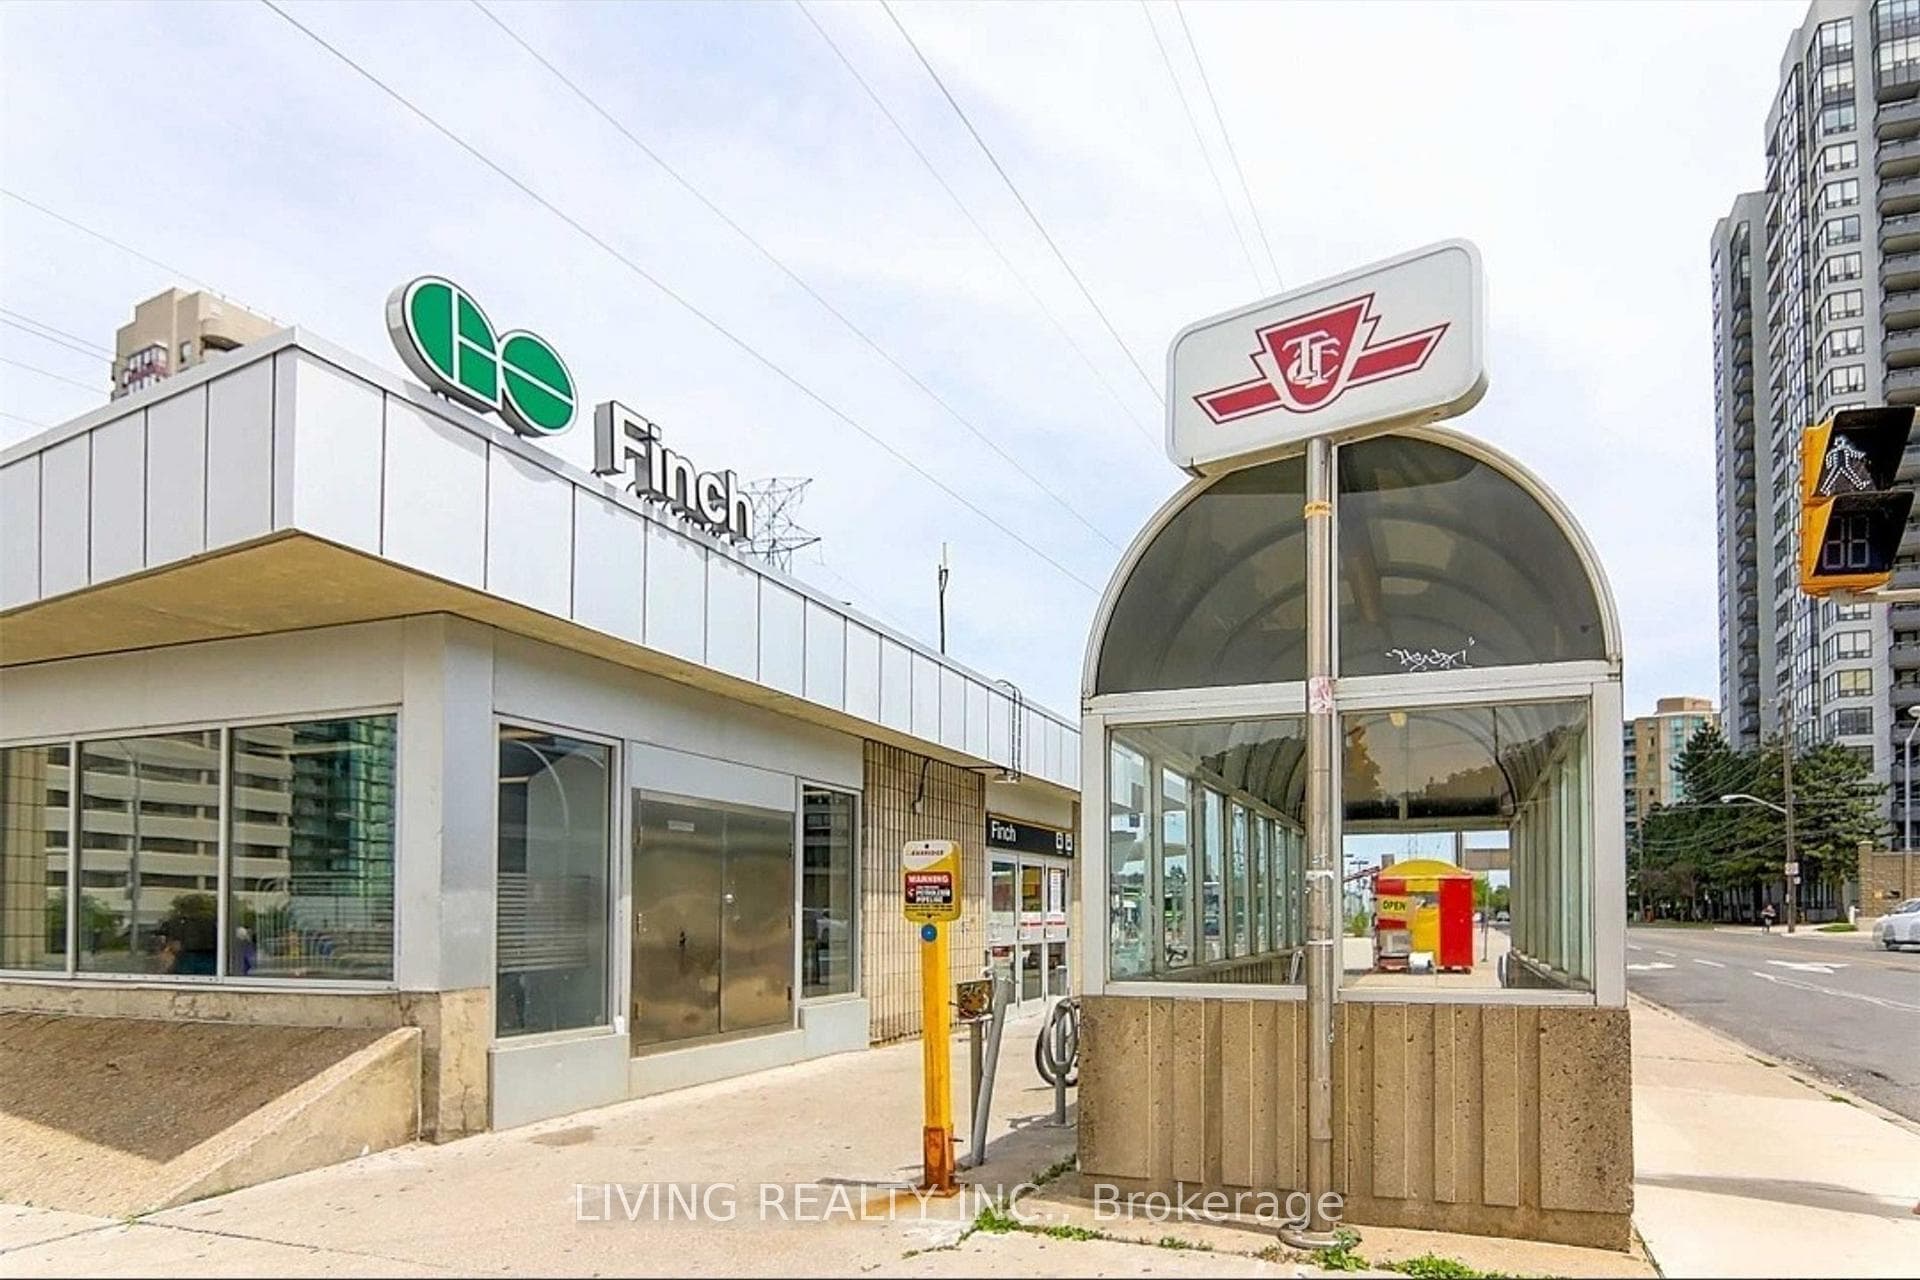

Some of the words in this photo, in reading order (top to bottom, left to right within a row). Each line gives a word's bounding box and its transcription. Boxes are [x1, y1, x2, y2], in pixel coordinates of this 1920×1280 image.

[600, 401, 754, 541] Finch
[991, 820, 1017, 843] Finch
[907, 874, 950, 883] WARNING
[1382, 900, 1407, 911] OPEN
